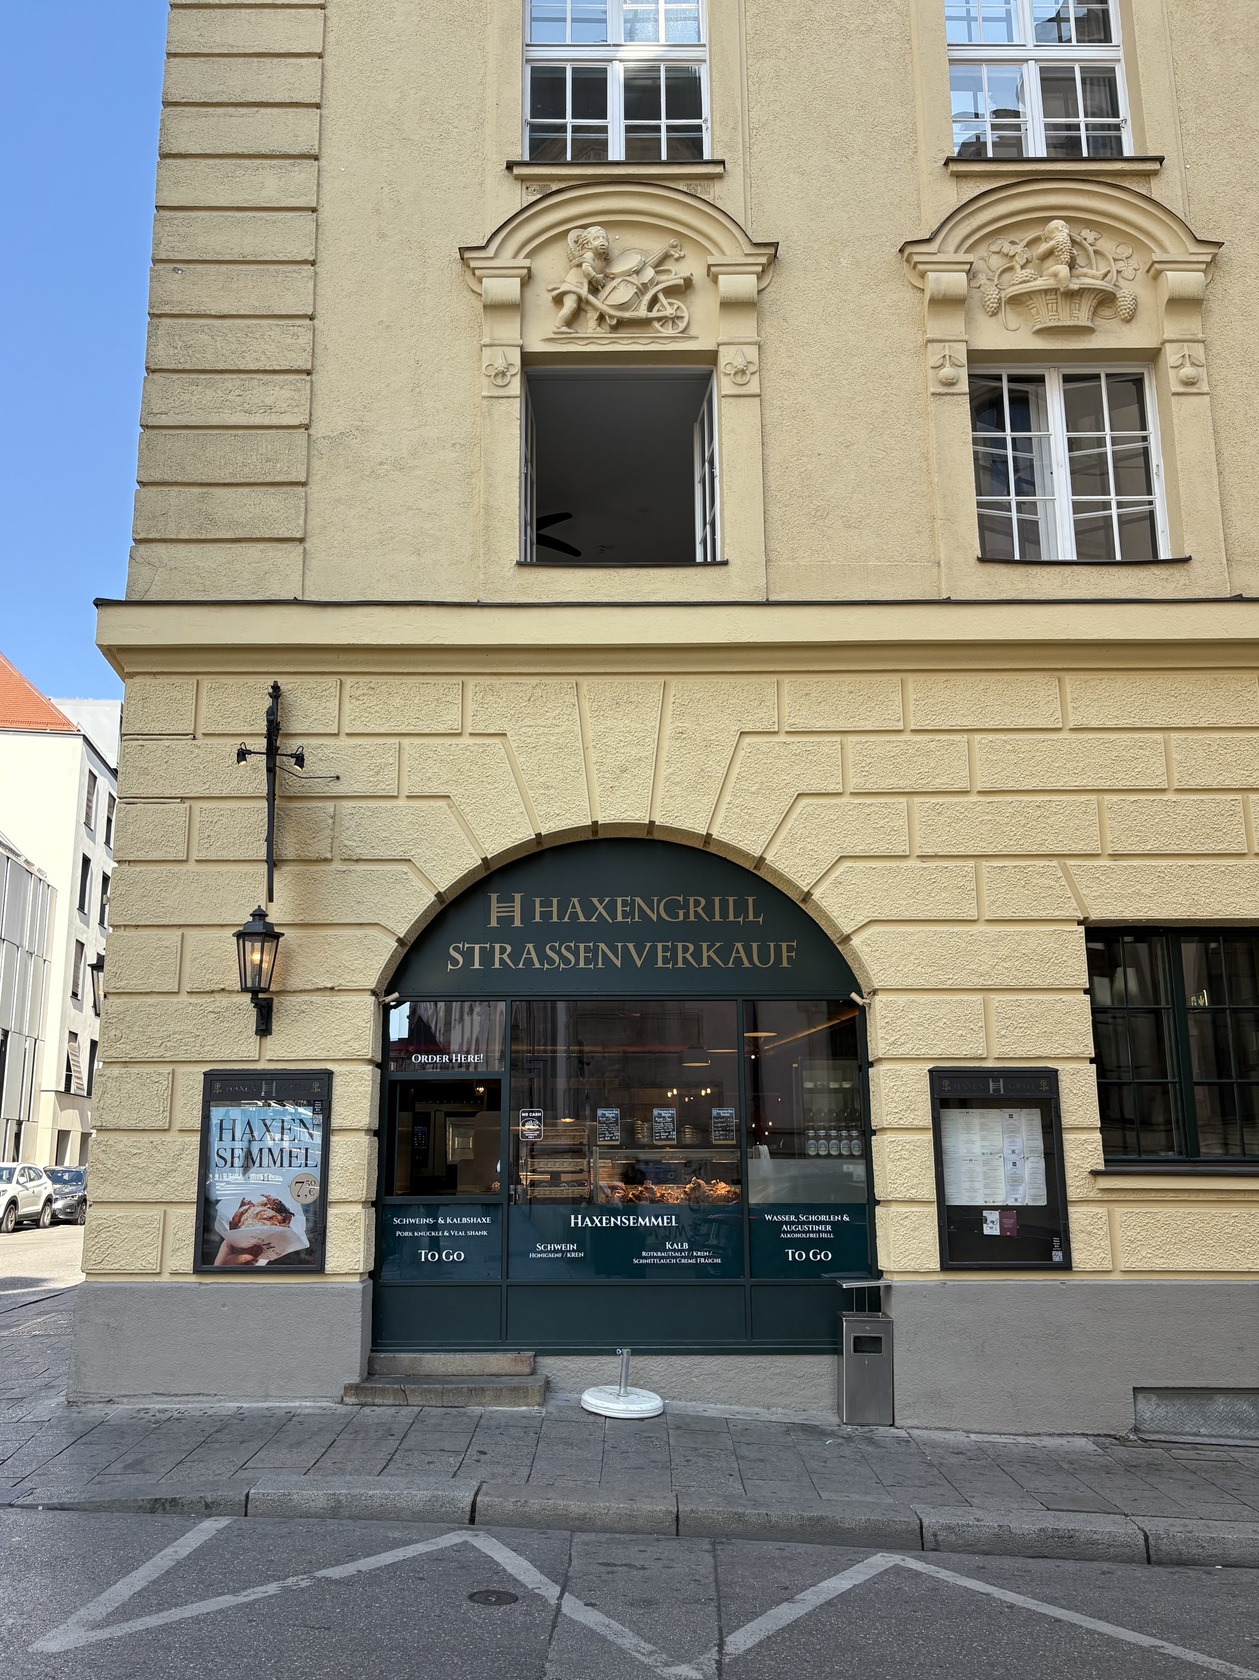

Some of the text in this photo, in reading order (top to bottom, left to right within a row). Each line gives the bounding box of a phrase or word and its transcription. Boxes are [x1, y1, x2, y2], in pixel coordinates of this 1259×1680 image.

[531, 894, 764, 926] HAXENGRILL
[447, 939, 797, 972] STRASSENVERKAUF
[411, 1053, 484, 1064] ORDER HERE!
[217, 1118, 316, 1142] HAXEN
[215, 1147, 318, 1169] SEMMEL
[392, 1216, 492, 1225] SCHWEINS- & KALBSHAXE
[570, 1214, 679, 1228] HAXENSEMMEL
[764, 1214, 850, 1222] WASSER, SCHORLEN &
[536, 1242, 577, 1252] SCHWEIN
[665, 1242, 689, 1250] KALB
[418, 1249, 465, 1262] TO GO
[784, 1248, 832, 1262] TO GO
